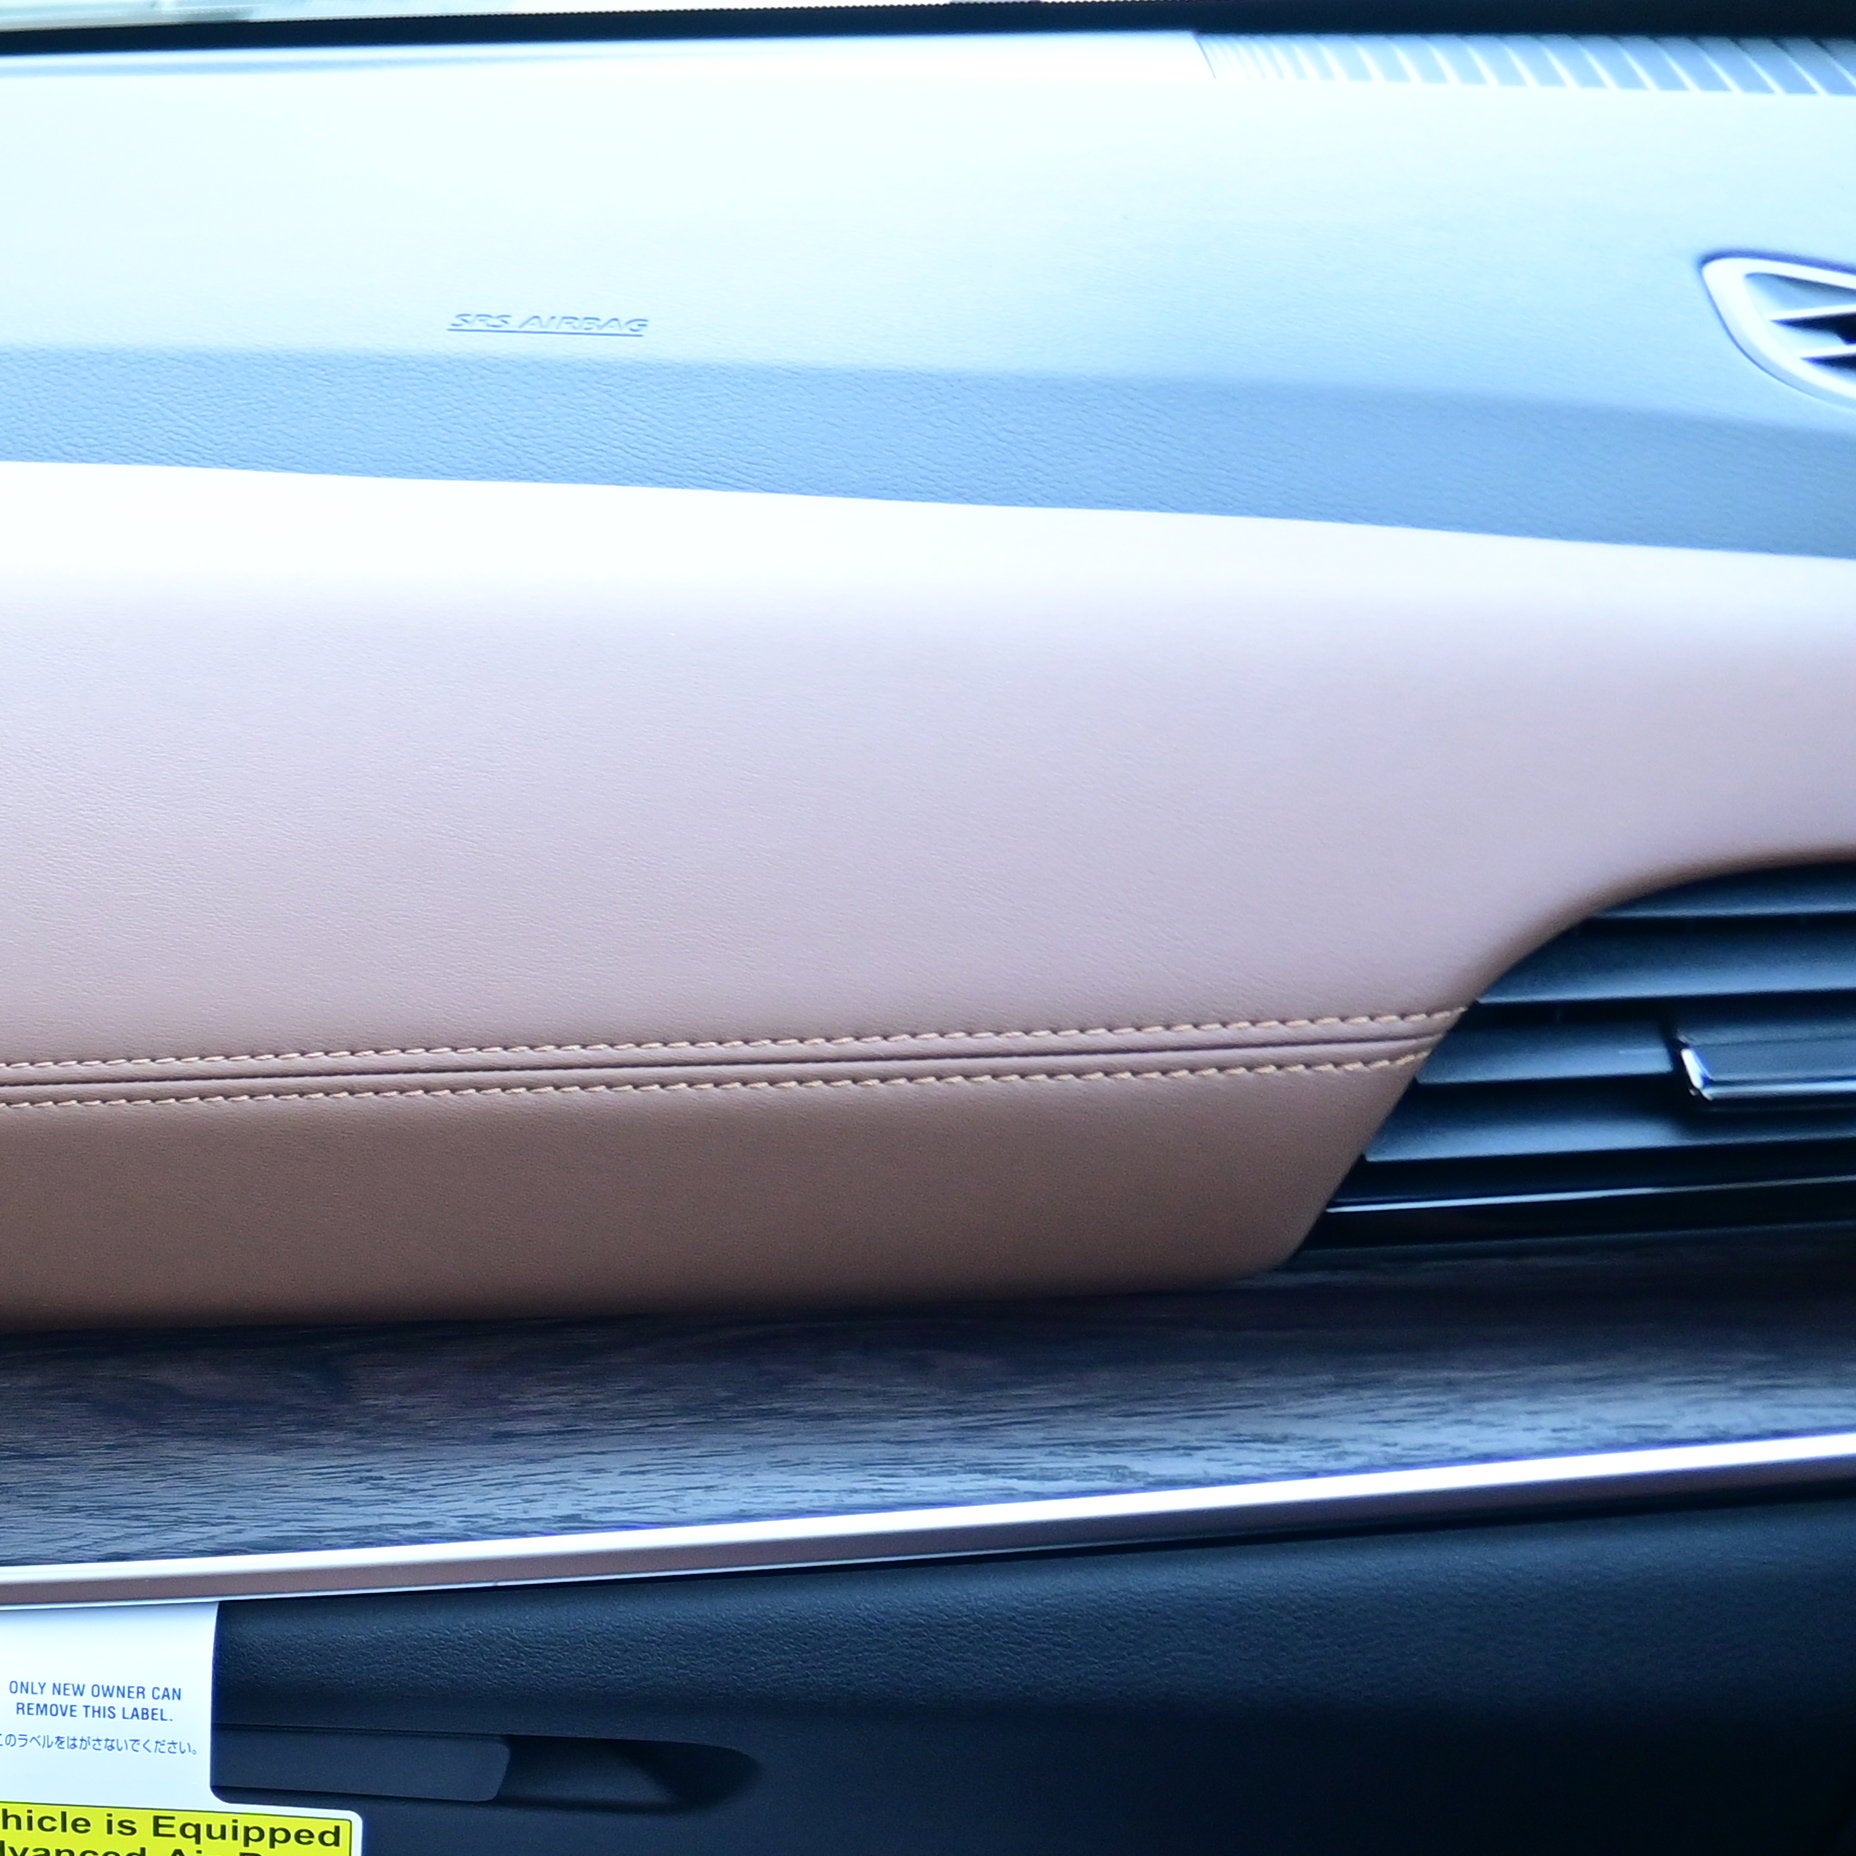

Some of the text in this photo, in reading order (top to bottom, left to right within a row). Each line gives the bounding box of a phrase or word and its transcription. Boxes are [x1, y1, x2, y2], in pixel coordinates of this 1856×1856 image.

[450, 313, 649, 332] SRS AIRBAG
[9, 1680, 181, 1700] ONLY NEW OWNER CAN
[16, 1702, 173, 1721] REMOVE THIS LABEL.
[106, 1814, 137, 1837] is
[153, 1816, 340, 1849] Equipped
